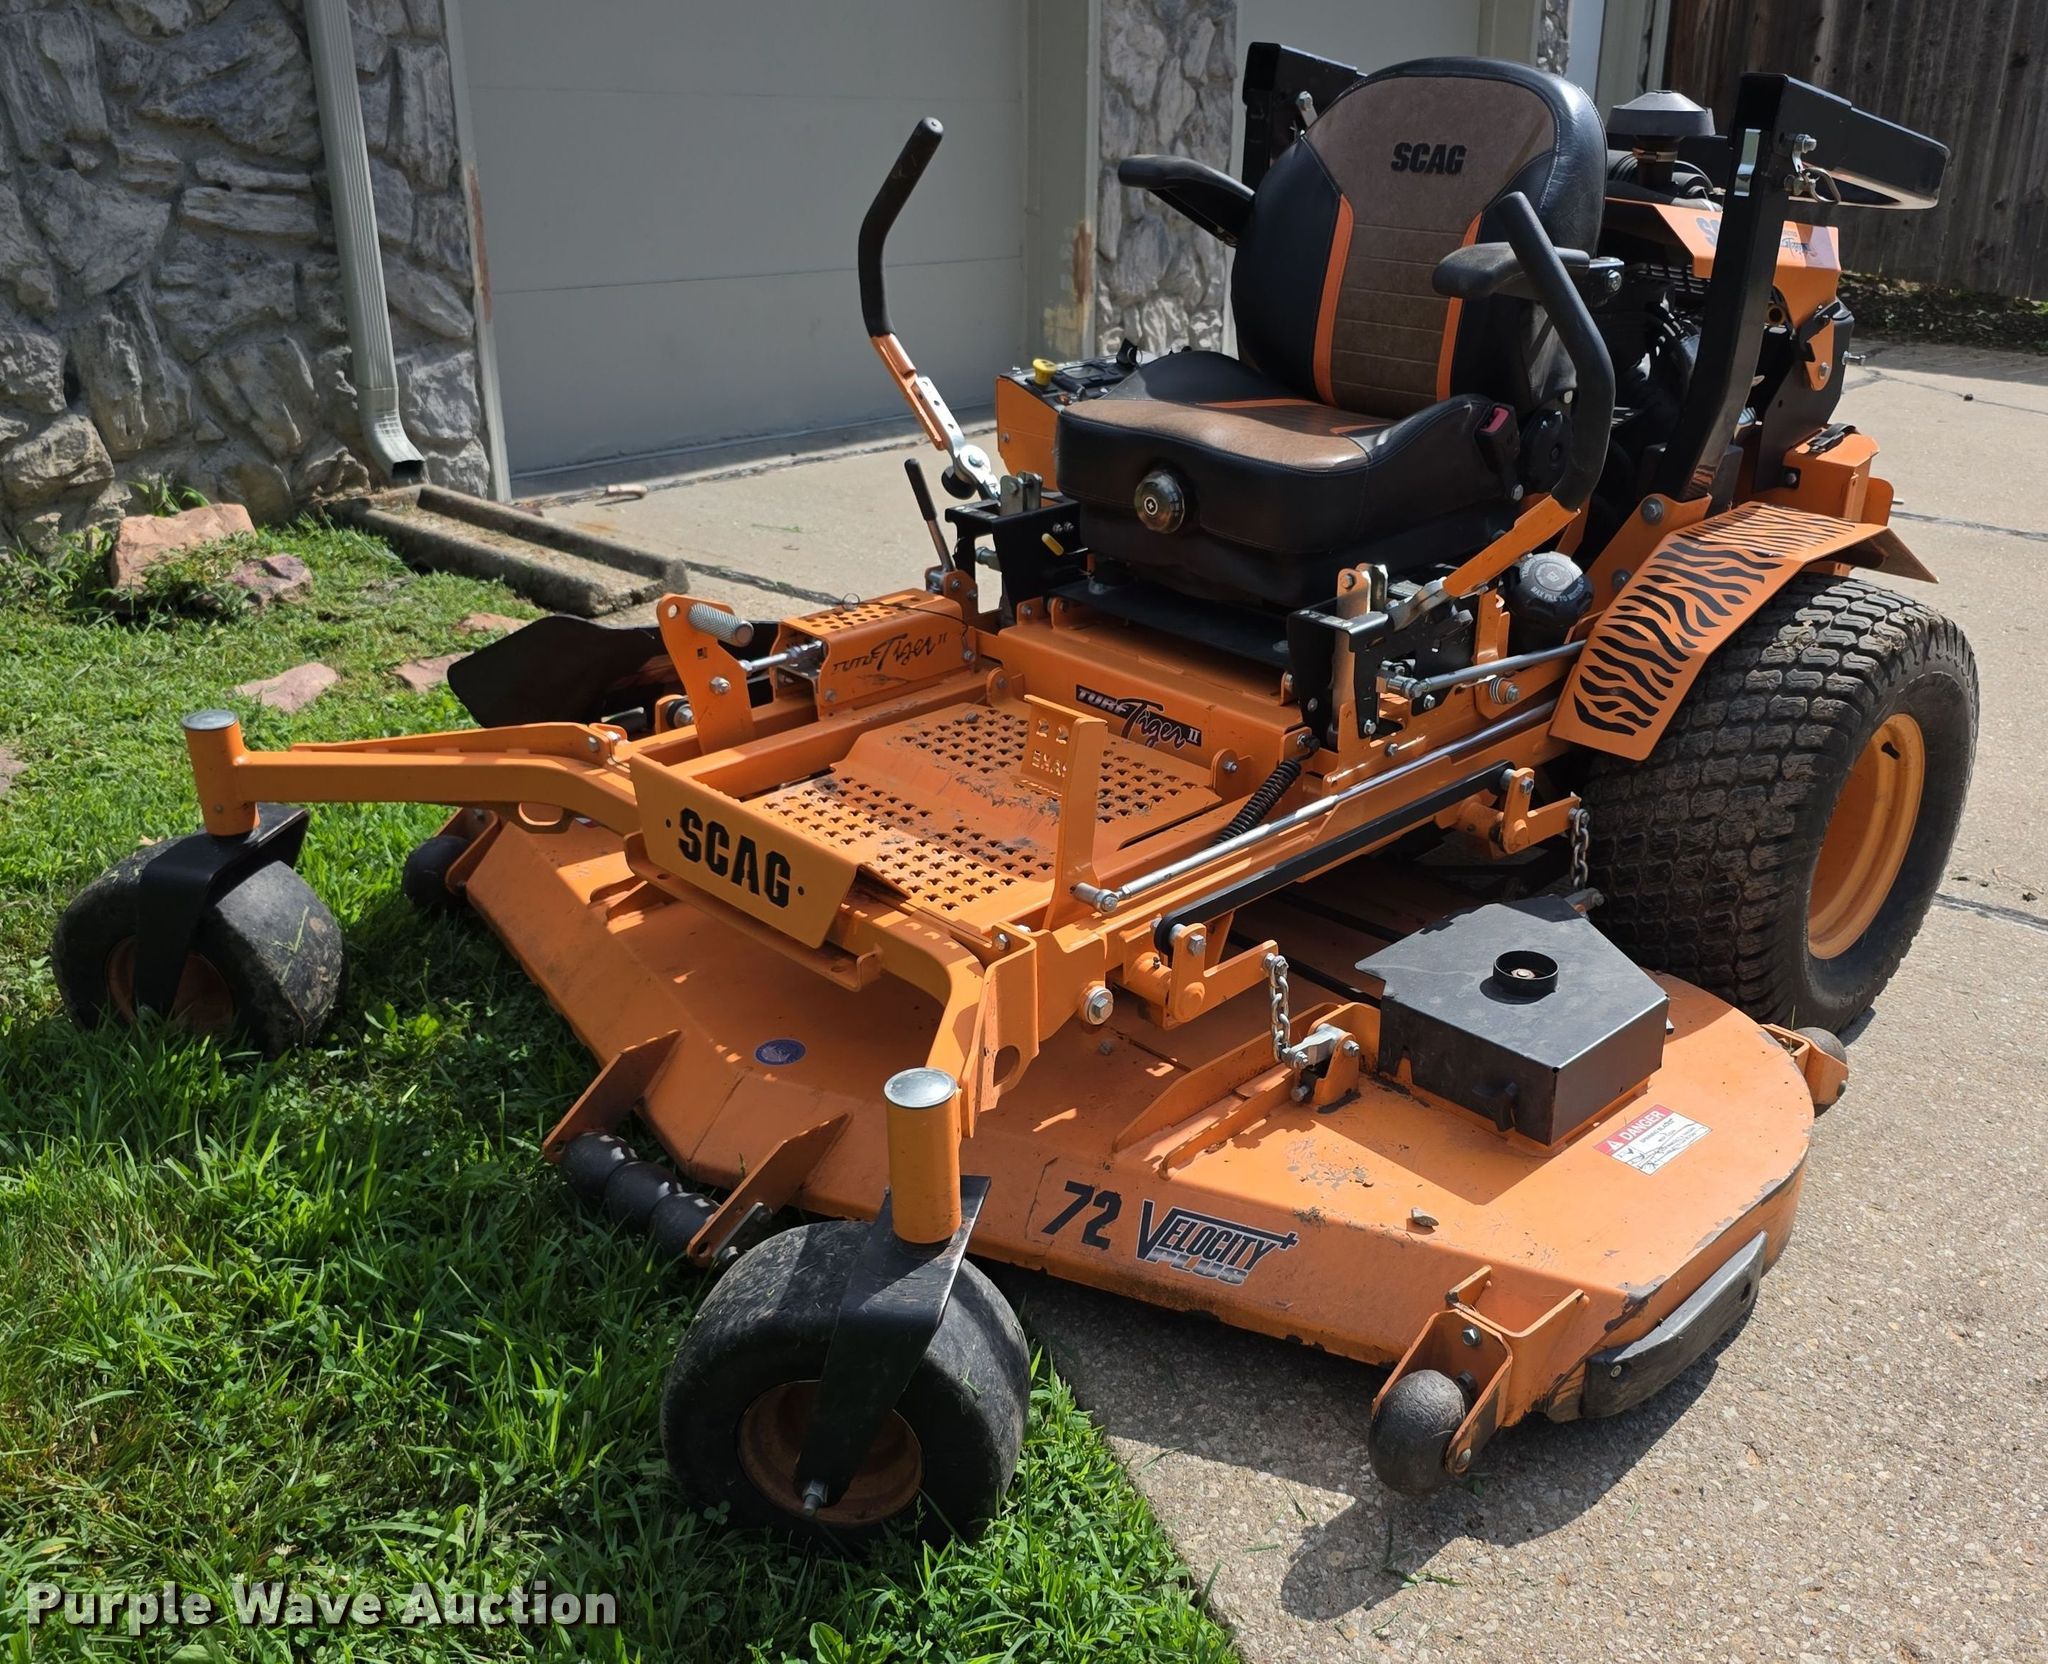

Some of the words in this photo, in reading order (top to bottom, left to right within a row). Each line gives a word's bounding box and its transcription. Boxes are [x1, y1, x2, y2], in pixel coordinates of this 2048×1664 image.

[1391, 142, 1467, 176] SCAG
[1078, 688, 1129, 714] TURF
[1117, 697, 1187, 750] Tiger
[1187, 727, 1200, 744] II
[678, 807, 791, 908] SCAG
[1618, 1110, 1667, 1141] DANGER
[1041, 1180, 1122, 1250] 72
[1148, 1247, 1250, 1286] PLUS
